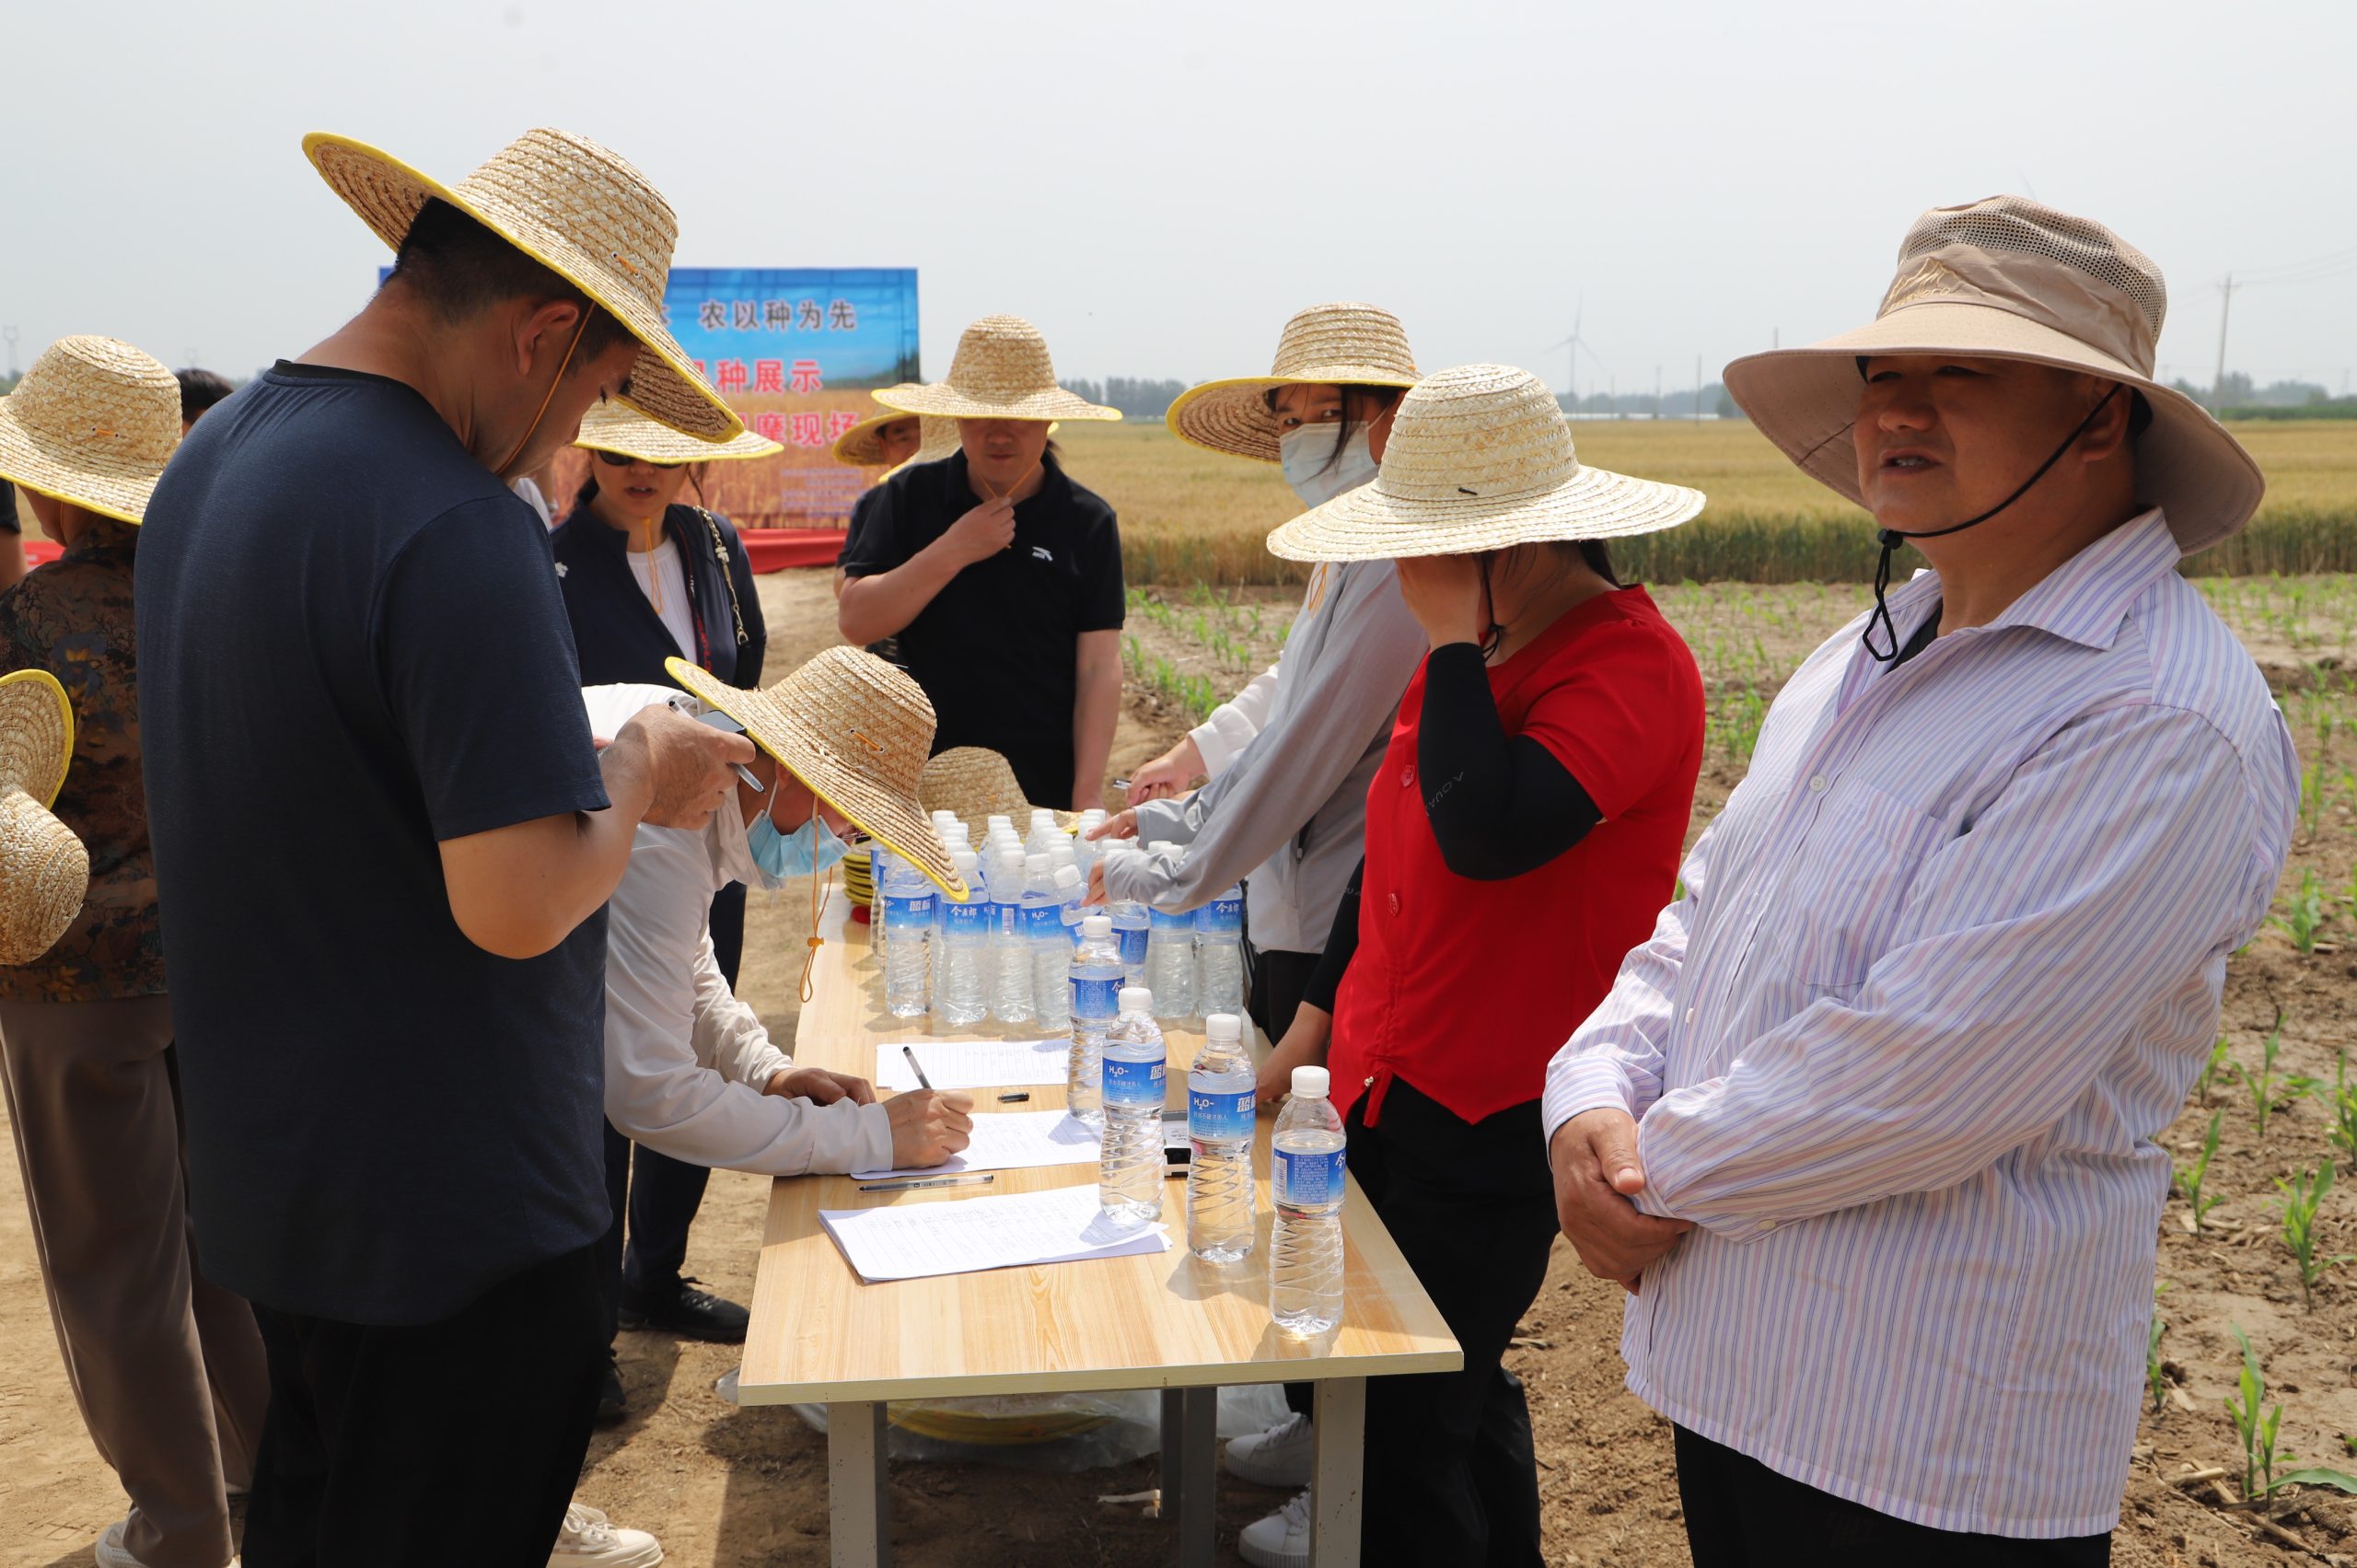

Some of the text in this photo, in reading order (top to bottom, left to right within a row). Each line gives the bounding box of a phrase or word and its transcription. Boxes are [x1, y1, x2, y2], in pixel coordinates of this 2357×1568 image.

[701, 300, 856, 331] 农以种为先
[737, 412, 858, 447] 摩现场
